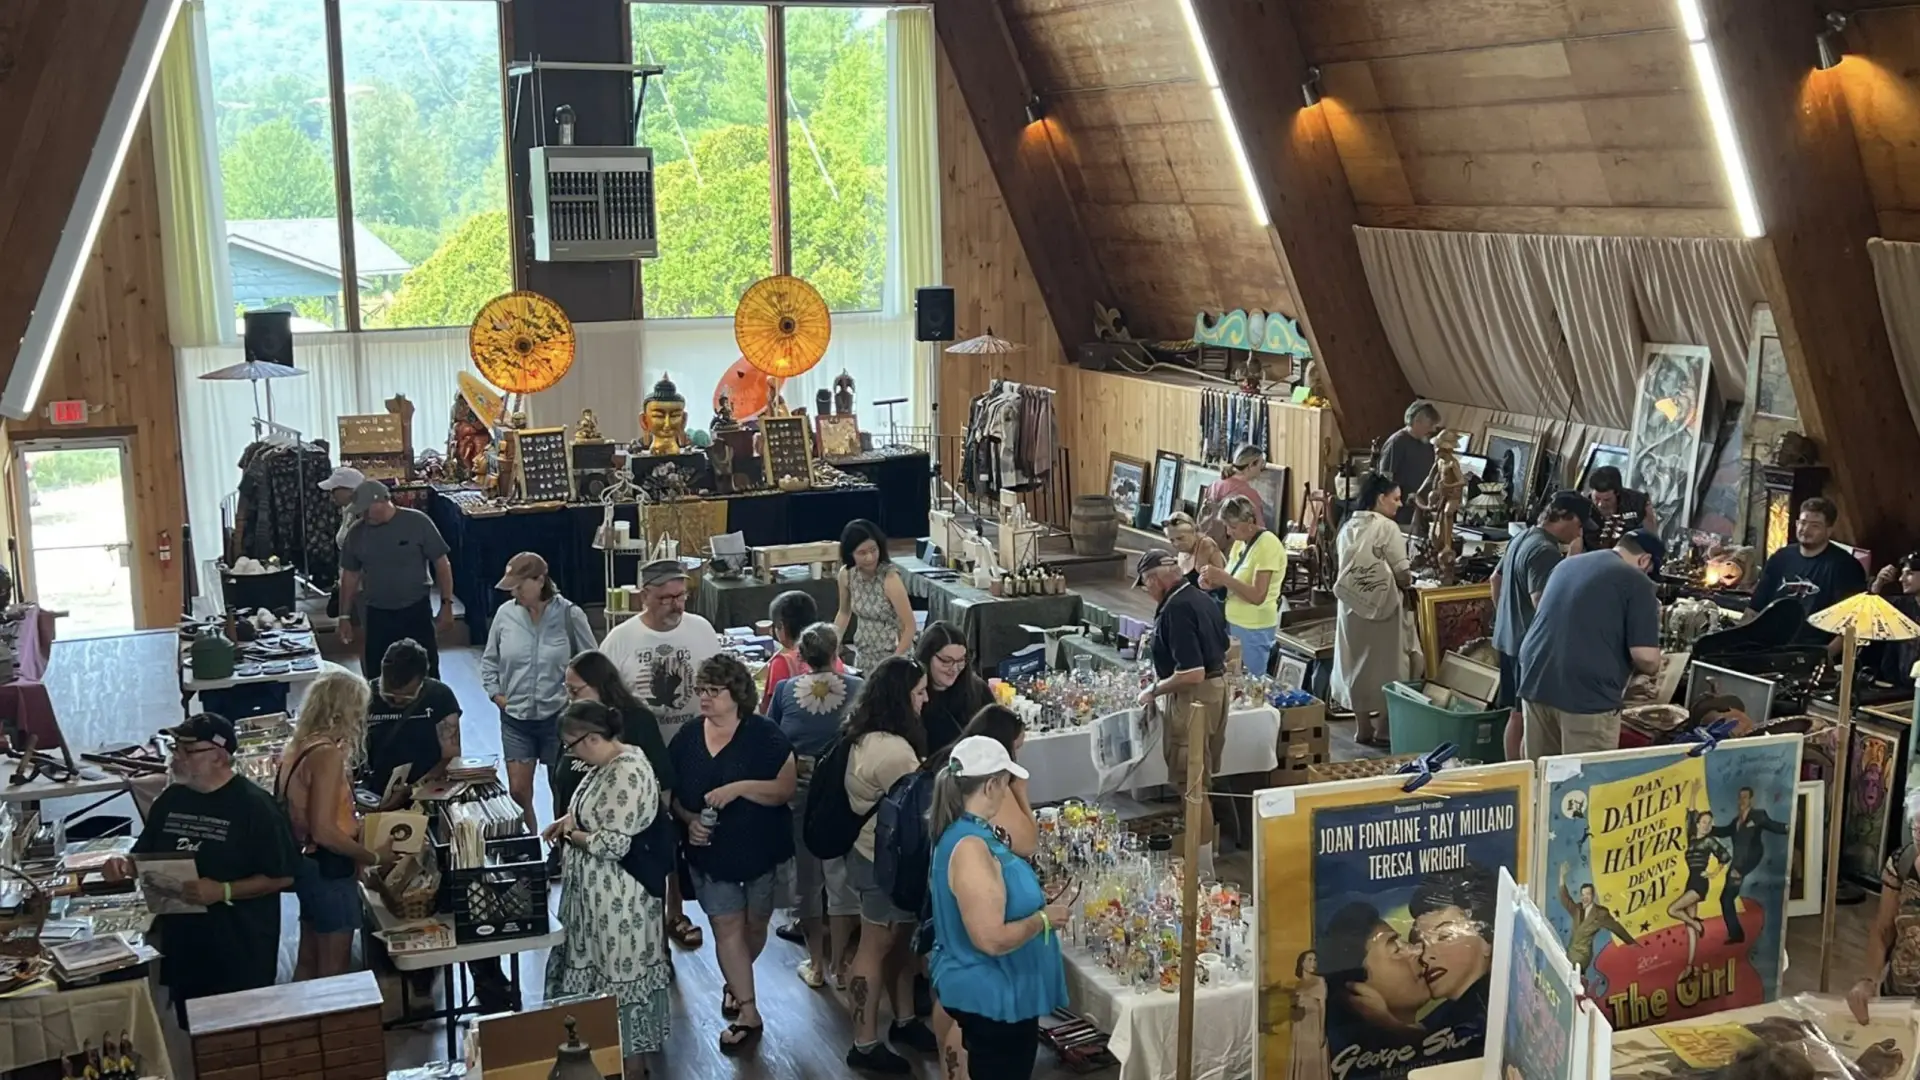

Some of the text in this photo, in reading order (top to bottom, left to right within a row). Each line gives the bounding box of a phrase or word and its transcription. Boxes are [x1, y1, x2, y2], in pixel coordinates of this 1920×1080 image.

[1632, 776, 1664, 798] DAN
[1601, 780, 1690, 834] DAILEY
[1319, 804, 1514, 855] JOAN FONTAINE RAY MILLAND
[1625, 817, 1668, 844] JUNE
[1369, 843, 1467, 880] TERESA WRIGHT
[1627, 855, 1678, 889] DENNIS
[1626, 871, 1676, 915] DAY
[1608, 982, 1669, 1030] The
[1676, 957, 1737, 1007] Girl
[1330, 1044, 1416, 1080] George
